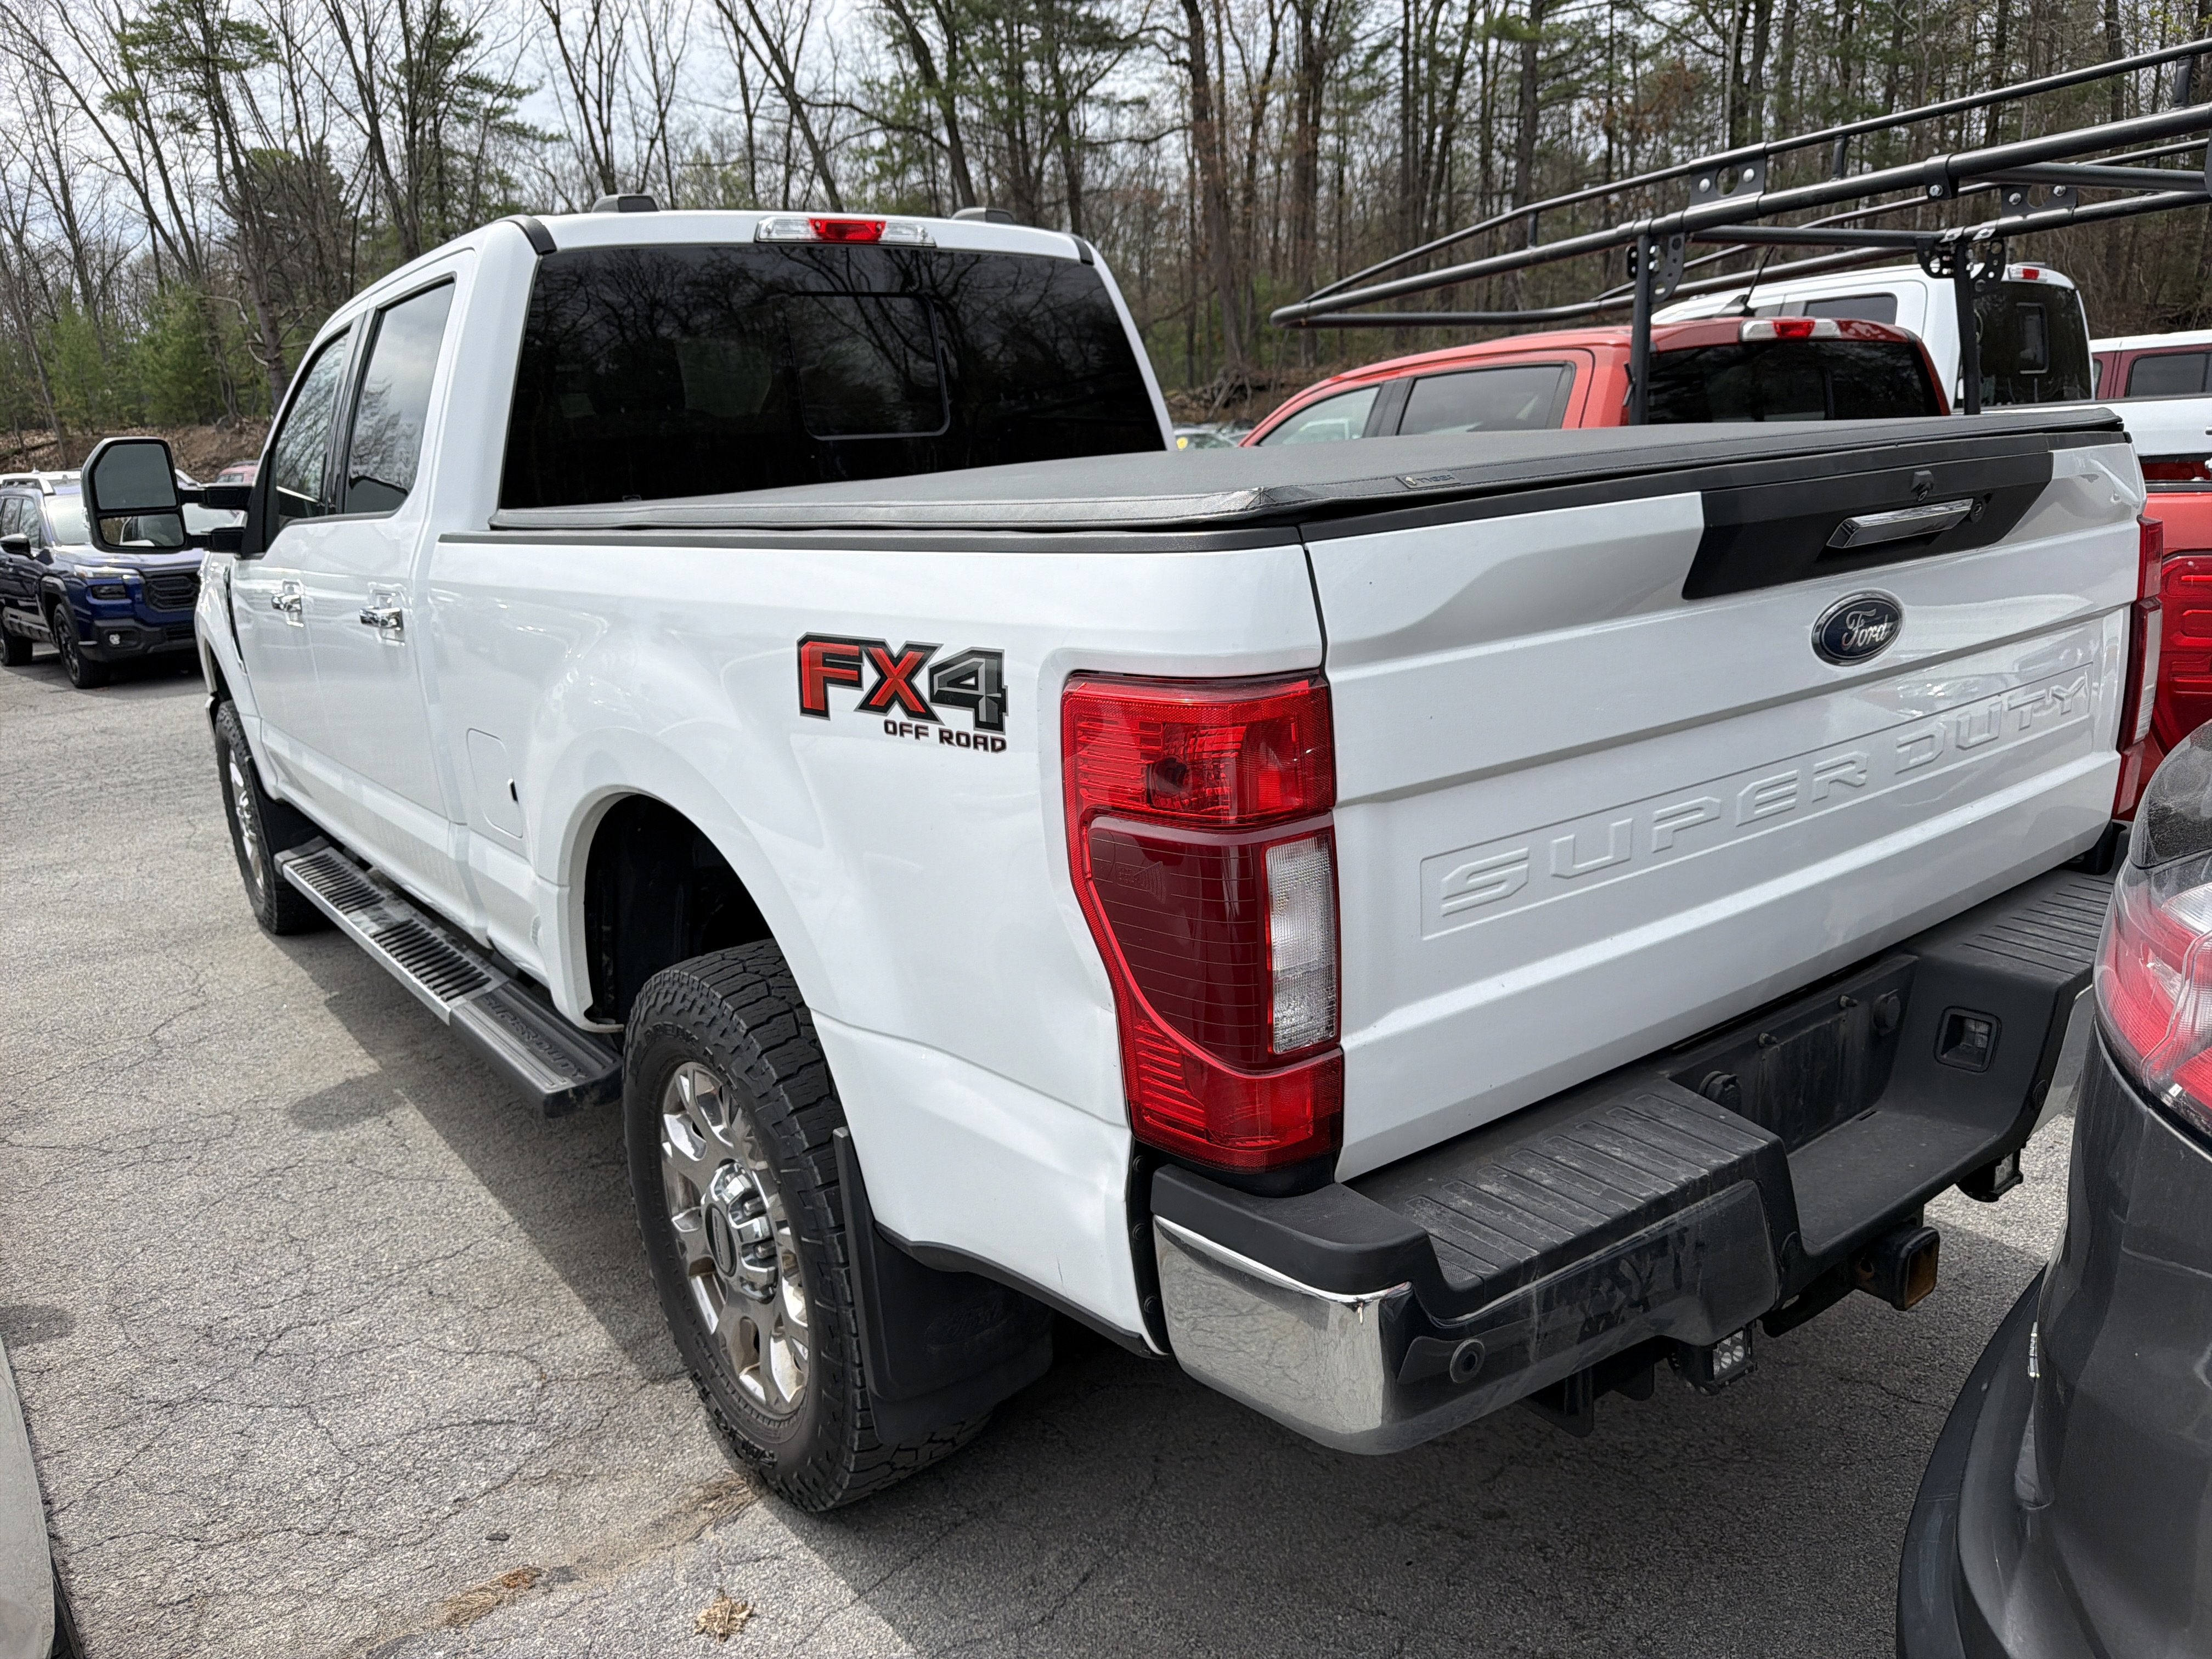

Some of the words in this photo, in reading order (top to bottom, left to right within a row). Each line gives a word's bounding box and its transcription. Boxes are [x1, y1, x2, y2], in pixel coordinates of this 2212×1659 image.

[1842, 608, 1889, 651] Ford
[797, 631, 1009, 735] FX4
[883, 719, 929, 741] OFF
[938, 727, 1007, 754] ROAD
[1441, 751, 1869, 917] SUPER
[1894, 675, 2087, 775] DUTY
